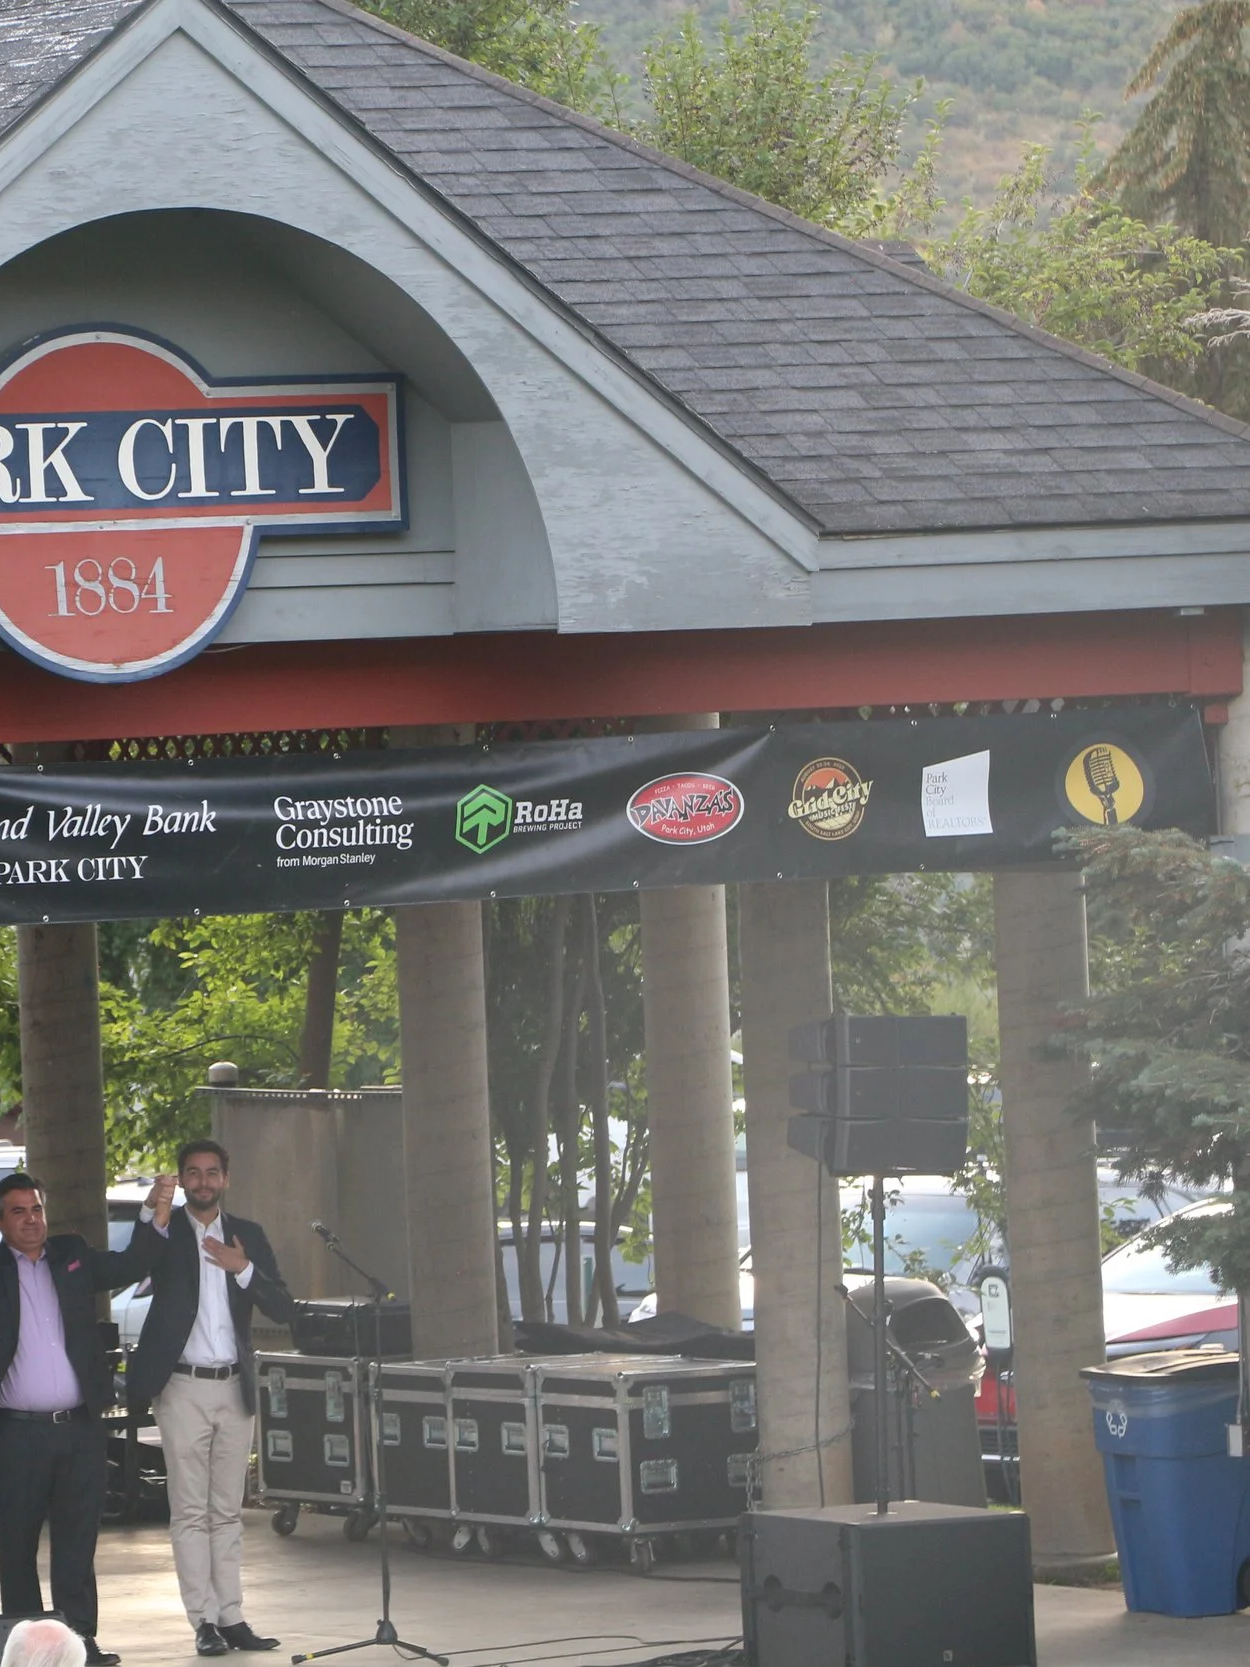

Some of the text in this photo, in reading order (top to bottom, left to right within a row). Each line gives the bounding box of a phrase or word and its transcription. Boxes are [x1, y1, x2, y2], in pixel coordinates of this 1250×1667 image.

[116, 412, 356, 502] CITY
[44, 556, 174, 617] 1884
[925, 784, 947, 797] City
[926, 772, 948, 784] Park
[273, 795, 403, 826] Graystone
[514, 798, 583, 824] RoHa
[788, 790, 829, 819] Grid
[832, 779, 874, 805] City
[46, 803, 132, 849] Valley
[142, 800, 217, 837] Bank
[275, 818, 414, 850] Consulting
[513, 821, 583, 834] BREWING PROJECT
[661, 823, 678, 835] Park
[697, 822, 715, 834] Utah
[77, 856, 148, 881] CITY
[276, 852, 376, 868] from Morgan Stanley
